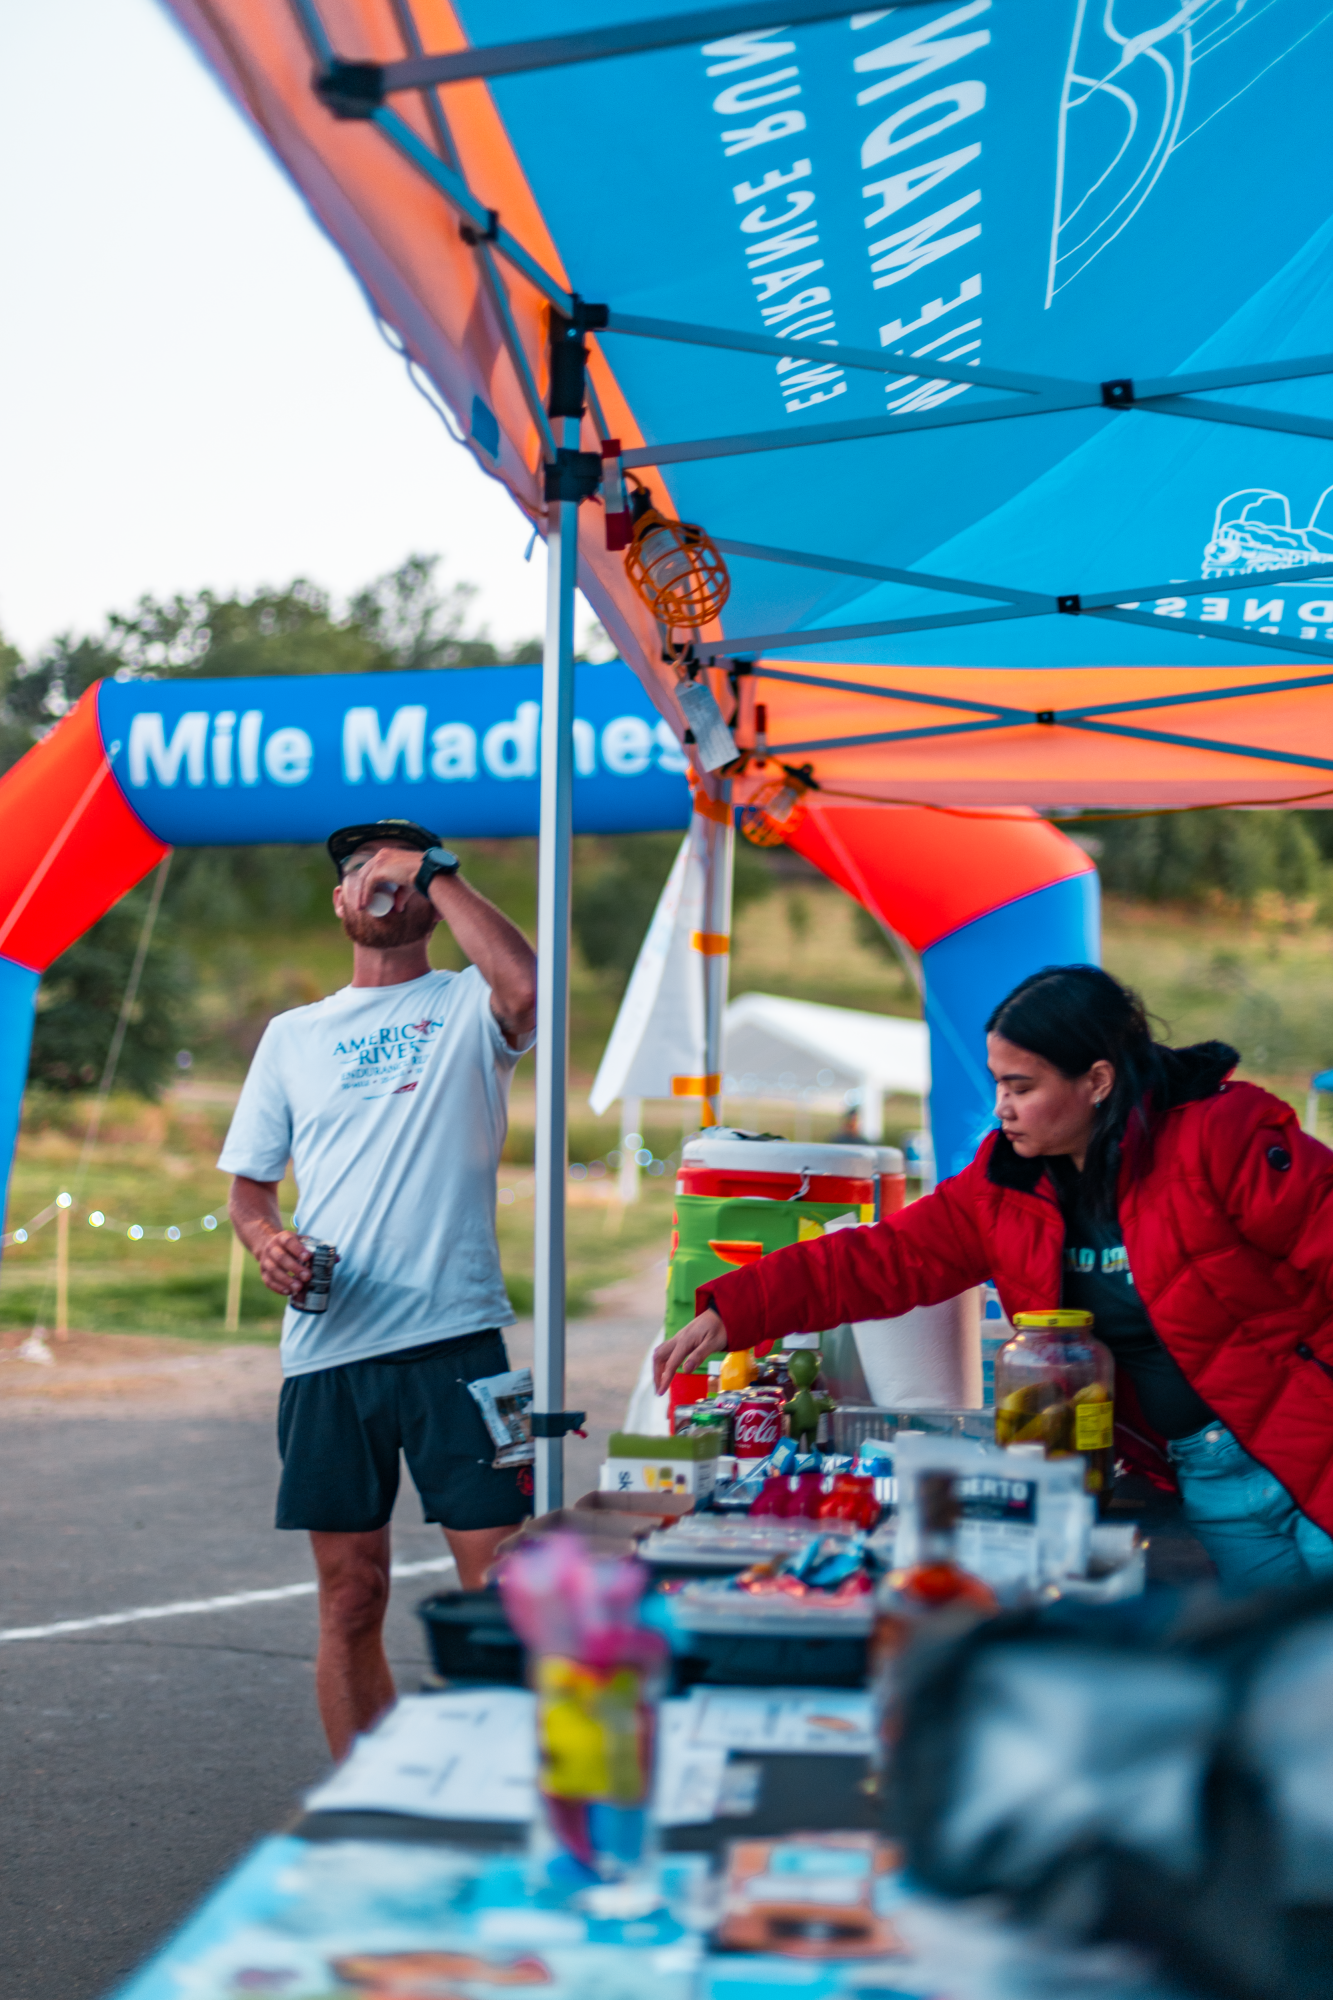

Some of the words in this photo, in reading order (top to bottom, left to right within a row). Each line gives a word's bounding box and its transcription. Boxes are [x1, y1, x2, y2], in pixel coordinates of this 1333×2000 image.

[128, 710, 313, 787] Mile
[332, 1016, 445, 1056] AMERICN
[358, 1040, 422, 1065] RIVER
[735, 1408, 779, 1443] Cola
